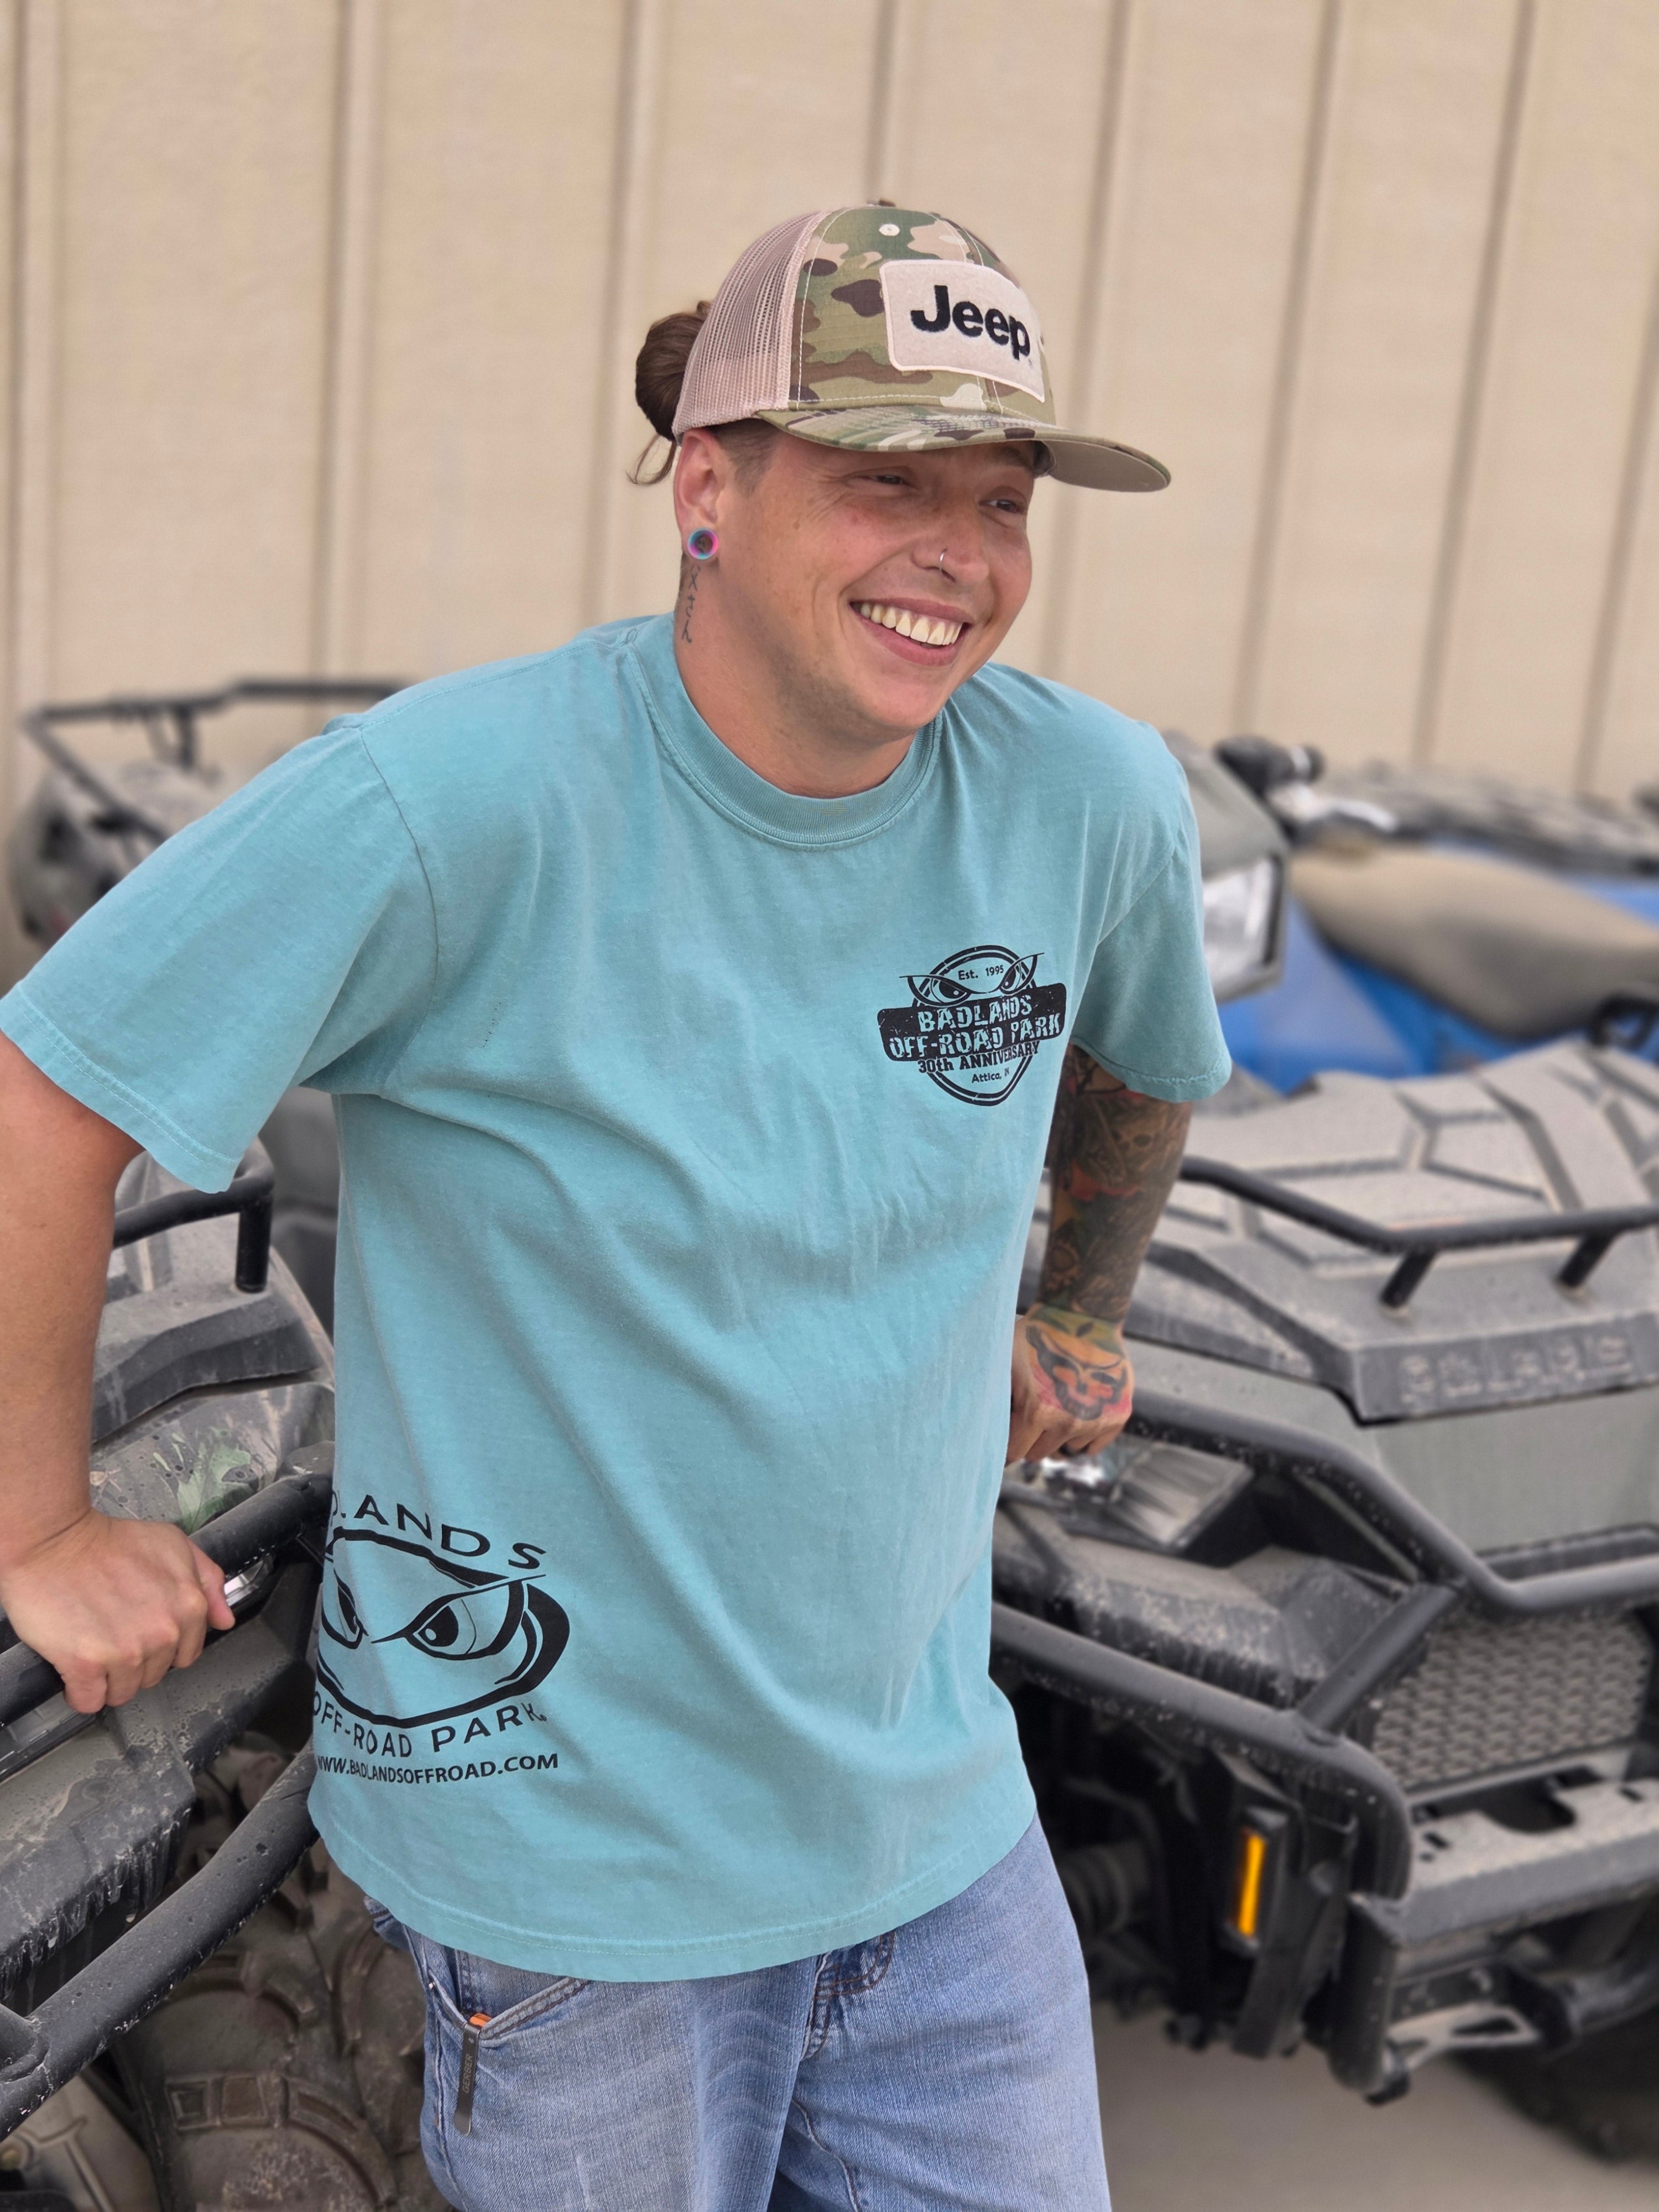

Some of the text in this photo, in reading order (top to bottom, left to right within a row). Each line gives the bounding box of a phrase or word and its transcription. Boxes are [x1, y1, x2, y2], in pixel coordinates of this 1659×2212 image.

[910, 284, 1031, 361] Jeep
[958, 964, 1004, 980] Est. 1995
[917, 994, 1032, 1032] BADLANDS
[889, 1013, 1061, 1058] OFF-ROAD PARK
[918, 1040, 1040, 1073] 30th ANNIVERSARY
[313, 1691, 412, 1757] OFF-ROAD
